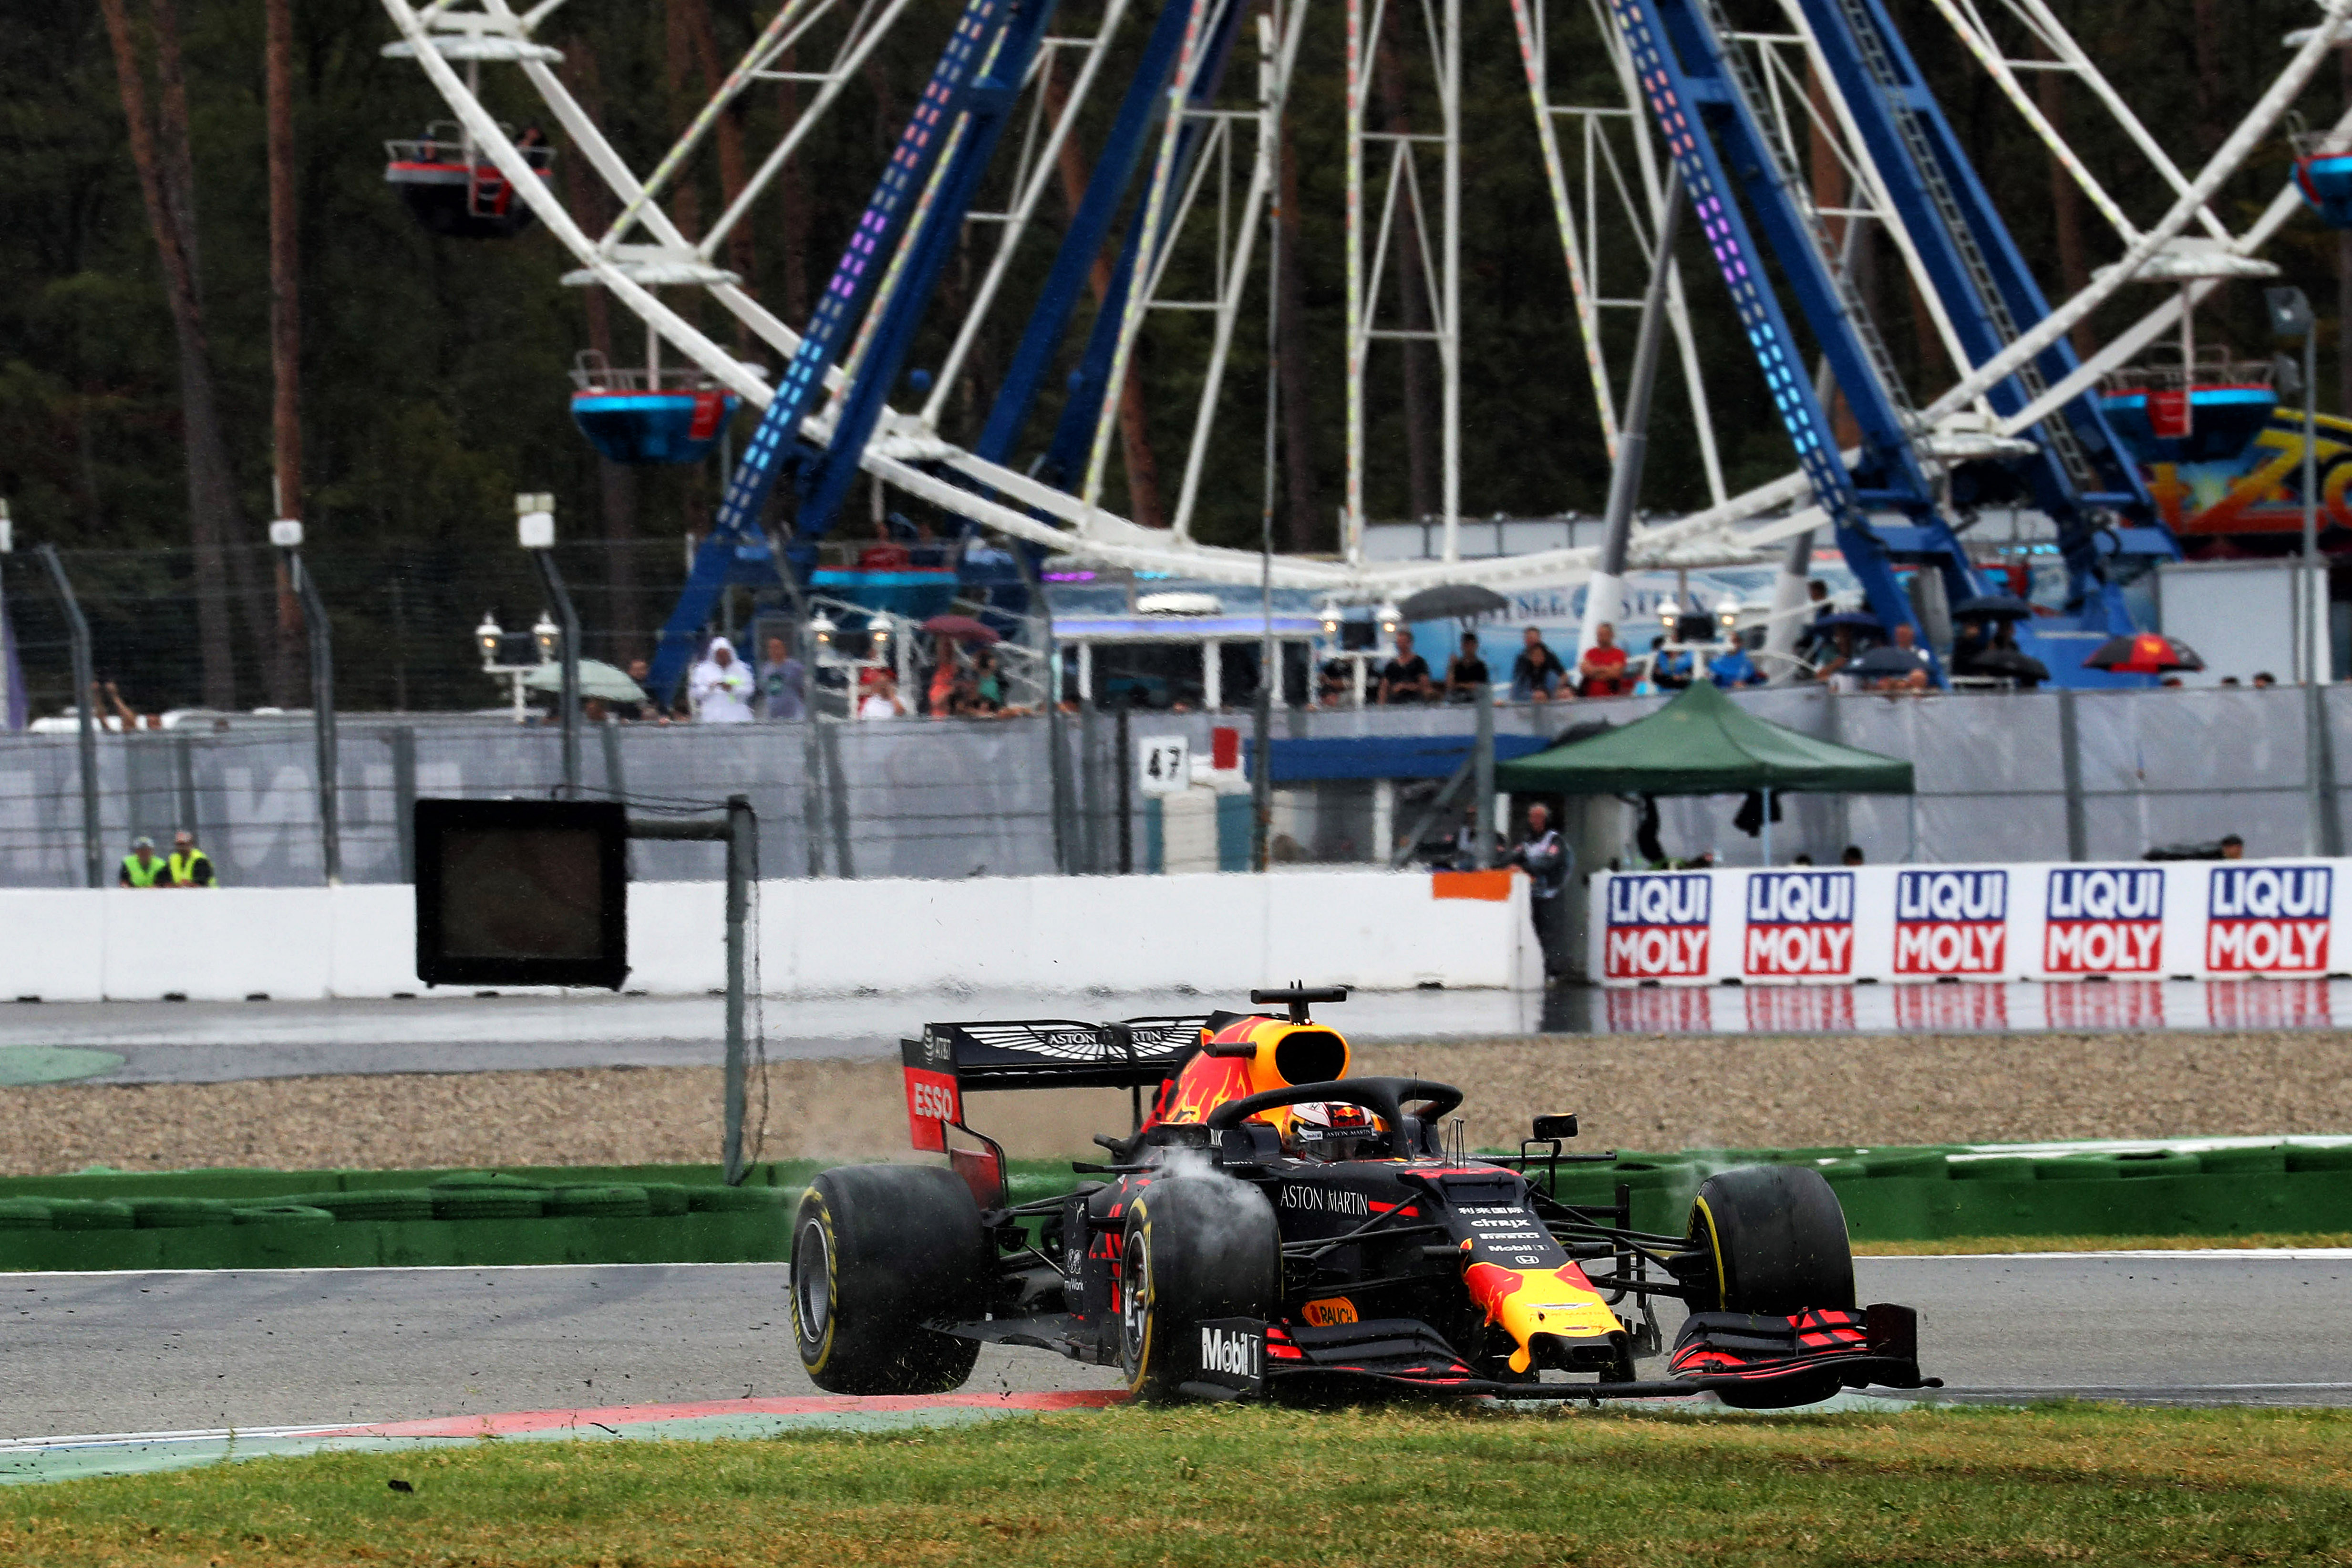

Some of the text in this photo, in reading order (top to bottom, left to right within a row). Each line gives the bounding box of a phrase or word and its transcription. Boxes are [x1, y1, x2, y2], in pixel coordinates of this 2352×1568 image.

[1147, 746, 1180, 779] 47
[1612, 878, 1708, 923] LIQUI
[1751, 876, 1850, 922] LIQUI
[1901, 874, 2003, 920] LIQUI
[2051, 871, 2159, 919] LIQUI
[2213, 870, 2328, 918] LIQUI
[1609, 929, 1708, 974] MOLY
[1749, 927, 1851, 972] MOLY
[1897, 925, 2004, 971] MOLY
[2048, 924, 2161, 970] MOLY
[2210, 922, 2327, 968] MOLY
[1049, 1033, 1096, 1044] ASTON
[915, 1082, 953, 1121] ESSO
[1280, 1185, 1367, 1216] ASTON MARTIN
[1319, 1306, 1352, 1325] RAUCH
[1201, 1327, 1248, 1376] Mobil
